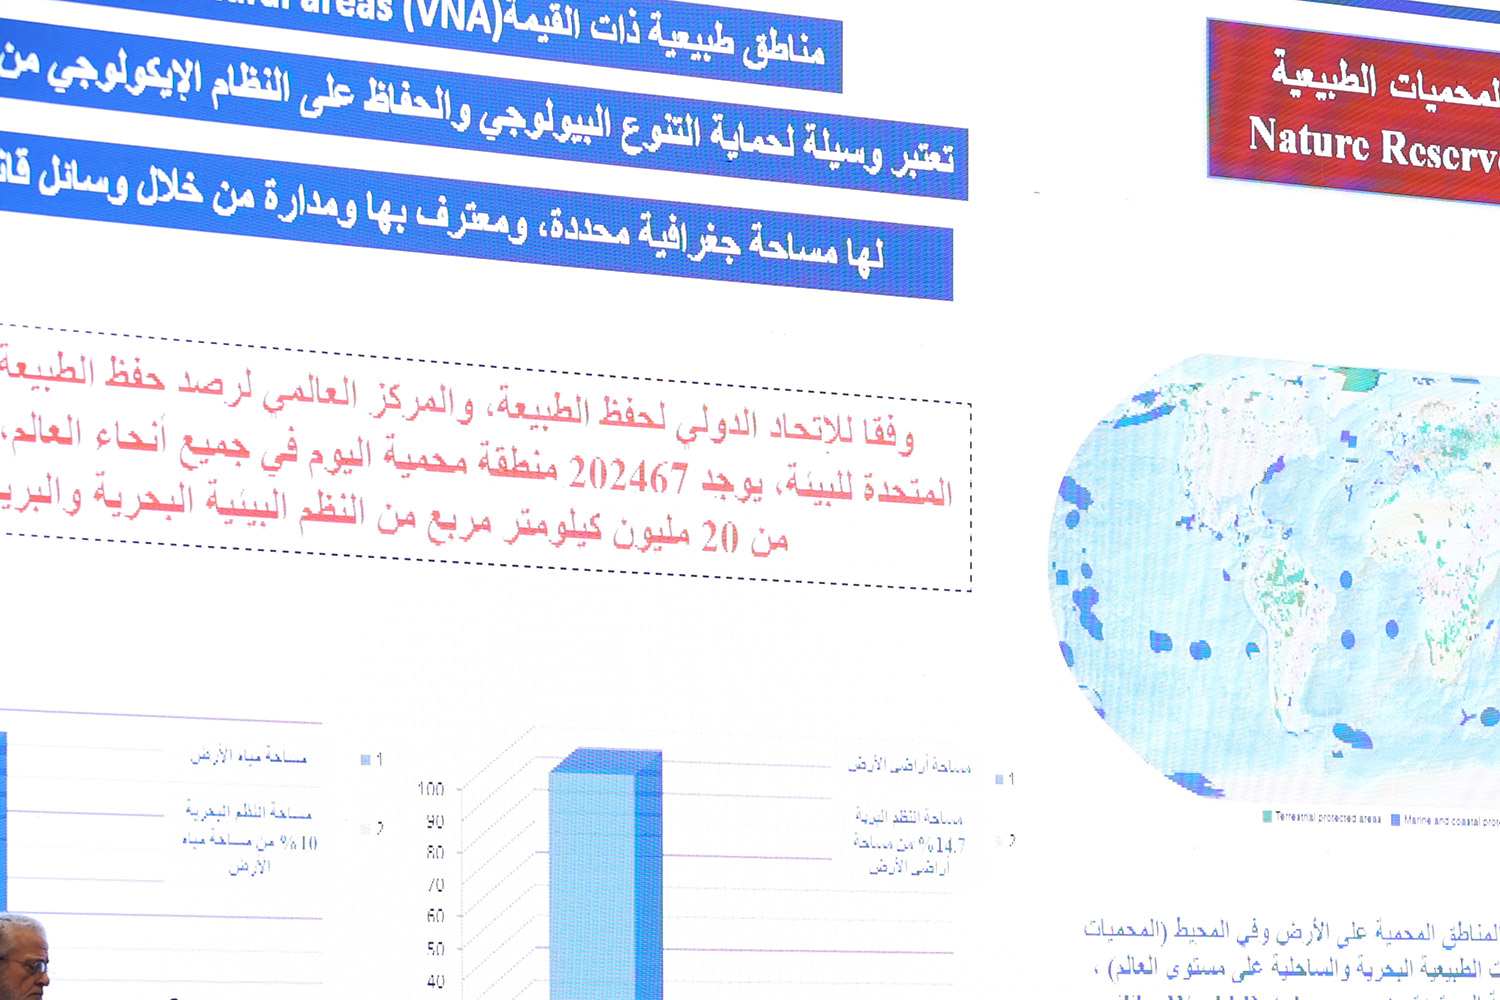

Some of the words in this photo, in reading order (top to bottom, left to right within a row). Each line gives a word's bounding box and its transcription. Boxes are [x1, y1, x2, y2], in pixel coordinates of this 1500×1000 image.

[591, 8, 640, 44] ذات
[648, 11, 734, 61] طبيعية
[0, 44, 39, 78] من
[743, 27, 824, 70] مناطق
[212, 62, 289, 109] النظام
[1272, 49, 1376, 100] الطبيعية
[300, 73, 354, 118] على
[364, 77, 470, 131] والحفاظ
[480, 98, 610, 145] البيولوجي
[622, 113, 700, 155] التنوع
[711, 114, 794, 160] لحماية
[1250, 116, 1369, 160] Nature
[803, 124, 882, 175] وسيلة
[891, 143, 954, 179] تعتبر
[138, 165, 203, 205] خلال
[213, 181, 254, 216] من
[265, 178, 356, 228] ومدارة
[367, 191, 406, 234] بها
[417, 196, 527, 245] ومعترف
[639, 211, 741, 264] جغرافية
[749, 222, 837, 263] مساحة
[847, 238, 883, 279] لها
[105, 355, 165, 390] حفظ
[178, 367, 252, 407] لرصد
[369, 383, 473, 425] والمركز
[599, 395, 666, 430] لحفظ
[179, 435, 250, 471] جميع
[309, 436, 371, 477] اليوم
[383, 433, 467, 479] محمية
[478, 440, 557, 480] منطقة
[569, 455, 688, 494] 202467
[702, 469, 763, 504] يوجد
[864, 473, 952, 506] المتحدة
[93, 471, 193, 521] البحرية
[299, 489, 364, 535] النظم
[377, 504, 416, 535] من
[428, 510, 491, 546] مربع
[504, 508, 602, 549] كيلومتر
[613, 514, 690, 553] مليون
[702, 520, 738, 553] 20
[751, 528, 788, 558] من
[418, 781, 444, 796] 100
[1375, 918, 1435, 947] المحمية
